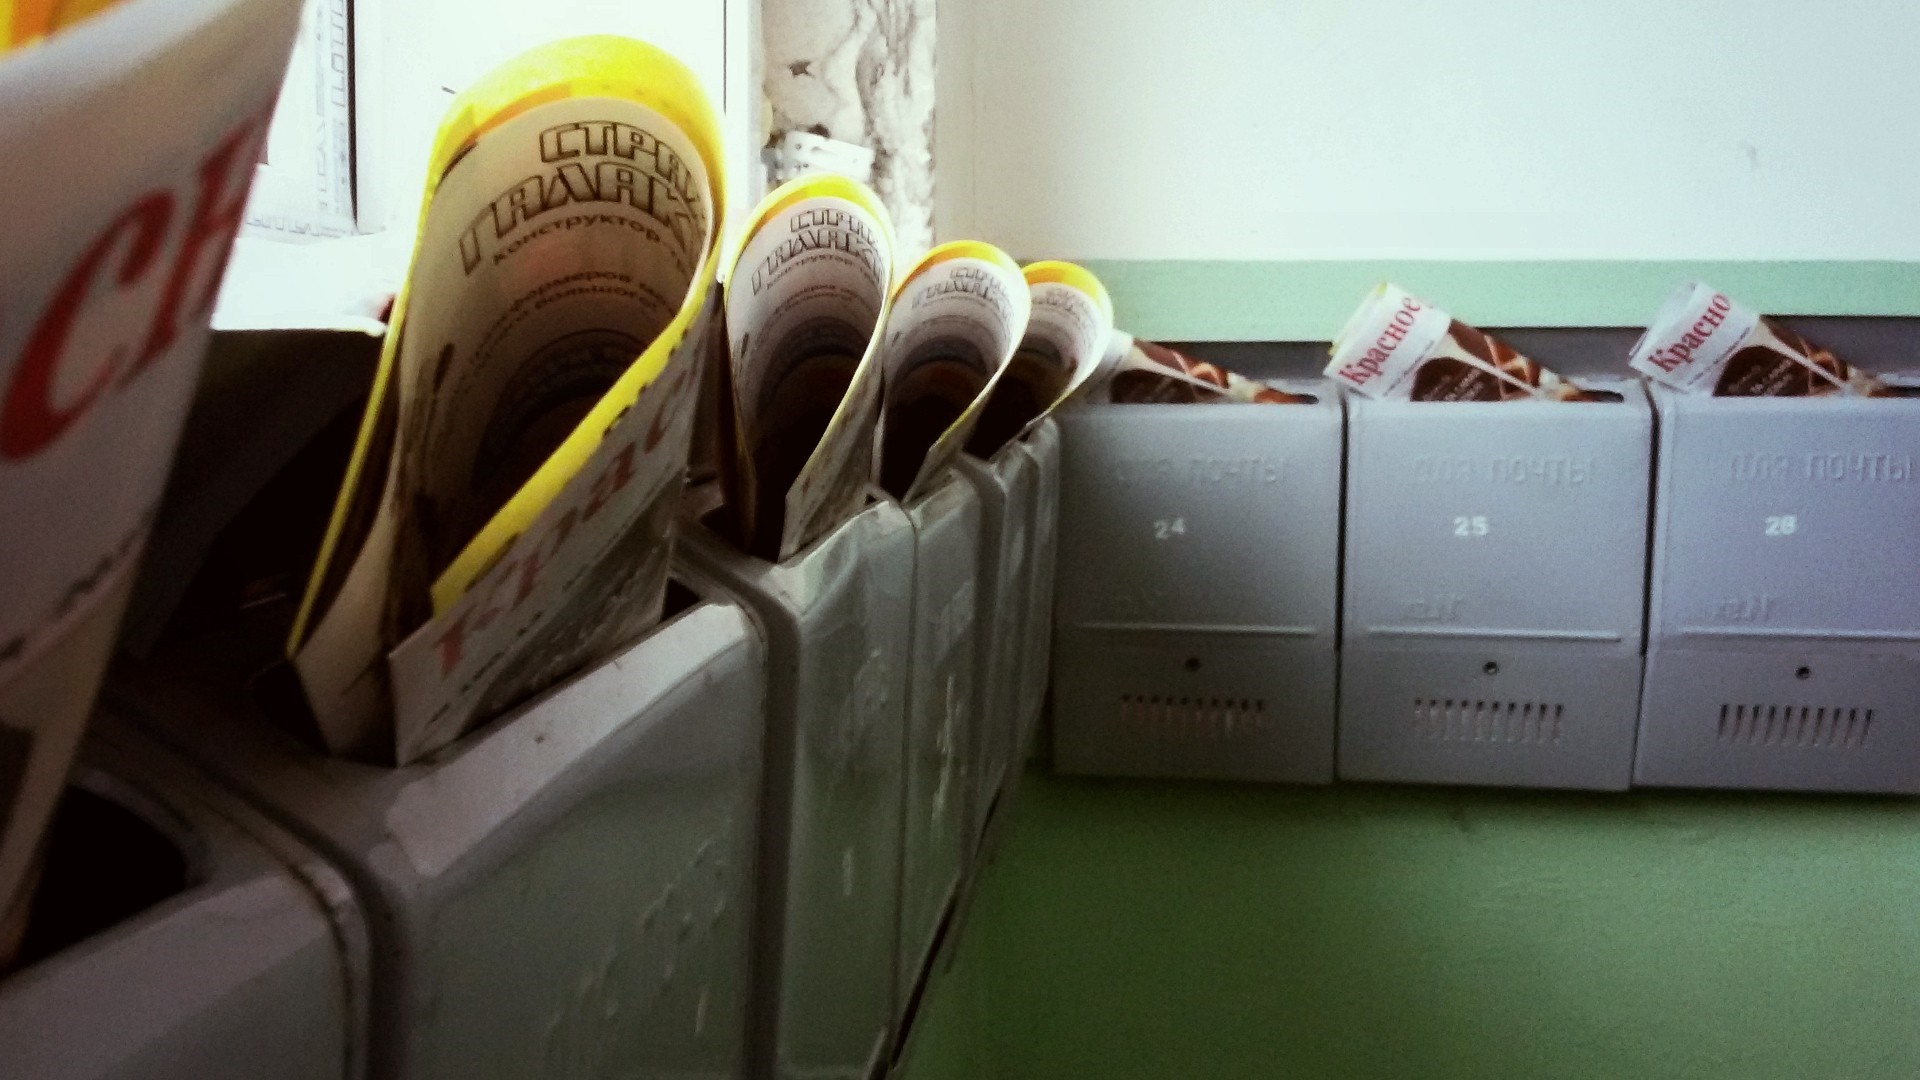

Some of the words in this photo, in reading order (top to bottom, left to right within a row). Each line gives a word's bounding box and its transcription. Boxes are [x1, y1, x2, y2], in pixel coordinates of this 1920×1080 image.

[459, 162, 702, 276] ГАЛАК
[494, 214, 661, 264] конструктор
[1338, 296, 1421, 386] Красное
[1647, 292, 1731, 373] Красно
[1807, 453, 1913, 482] ПОЧТЫ
[1153, 517, 1186, 541] 24
[1453, 515, 1489, 537] 25
